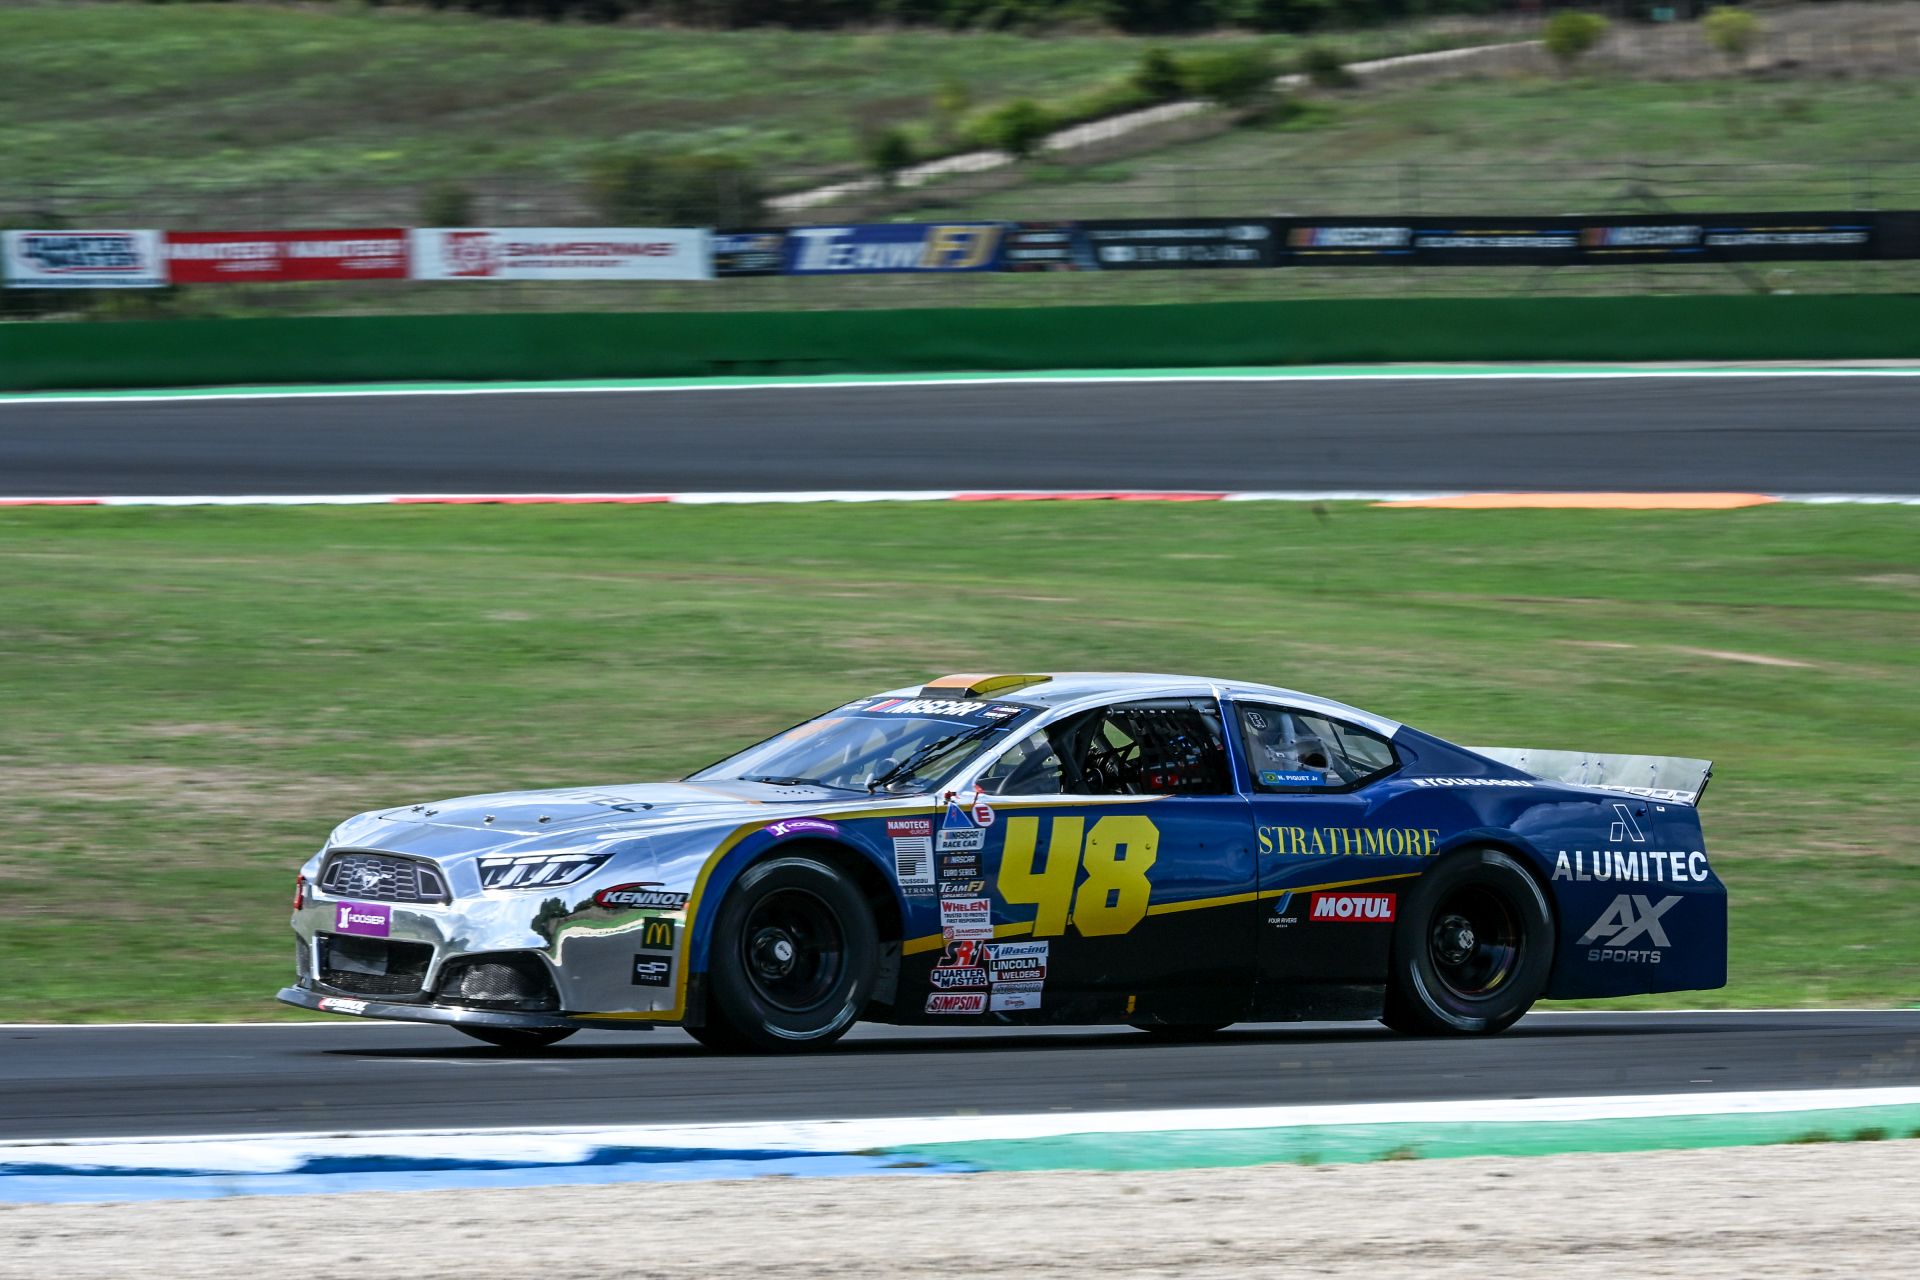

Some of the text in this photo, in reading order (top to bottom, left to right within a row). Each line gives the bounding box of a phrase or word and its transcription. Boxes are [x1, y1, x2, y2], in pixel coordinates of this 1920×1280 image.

[885, 700, 986, 716] NASCAR
[975, 807, 990, 822] E
[888, 821, 929, 829] NANOTECH
[952, 831, 979, 839] NASCAR
[1258, 827, 1440, 856] STRATHMORE
[1551, 850, 1708, 881] ALUMITEC
[996, 815, 1160, 938] 48
[602, 891, 686, 905] KENNOL
[942, 900, 988, 912] WHELEN
[1314, 897, 1391, 918] MOTUL
[349, 914, 385, 925] HOOSIER
[1575, 894, 1684, 947] AX
[1001, 945, 1047, 956] iRacing
[1588, 950, 1661, 963] SPORTS
[992, 959, 1036, 970] LINCOLN
[931, 969, 984, 982] QUARTER
[1001, 970, 1041, 979] WELDERS
[940, 977, 985, 987] MASTER
[931, 996, 982, 1010] SIMPSON
